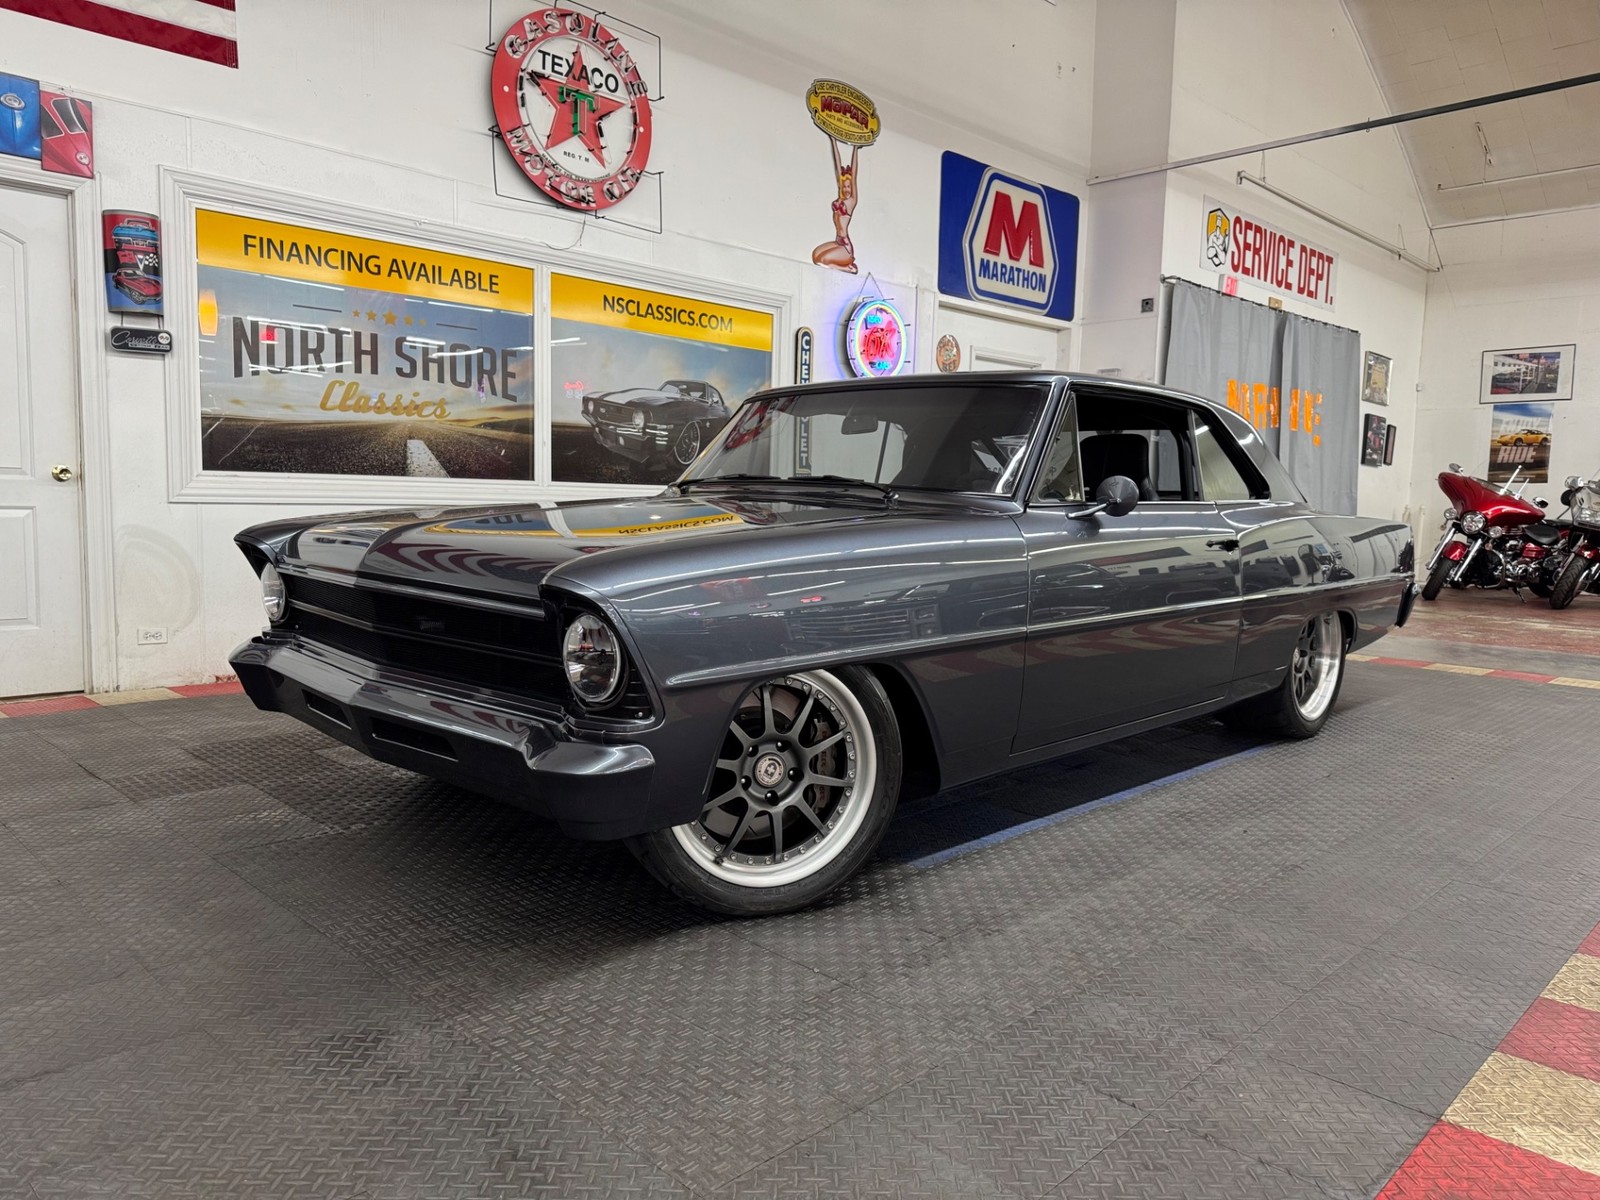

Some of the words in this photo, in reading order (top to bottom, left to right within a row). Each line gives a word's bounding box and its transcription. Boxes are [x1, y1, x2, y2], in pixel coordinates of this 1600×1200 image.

[538, 49, 619, 93] TEXACO
[506, 126, 597, 207] MOTOR
[983, 190, 1044, 269] M
[243, 233, 382, 276] FINANCING
[387, 258, 500, 295] AVAILABLE
[978, 257, 1046, 293] MARATHON
[1230, 215, 1295, 291] SERVICE
[1297, 243, 1334, 306] DEPT.
[603, 294, 733, 333] NSCLASSICS.COM
[232, 316, 379, 378] NORTH
[395, 335, 518, 403] SHORE
[320, 379, 451, 420] Classics
[1497, 446, 1537, 464] RIDE
